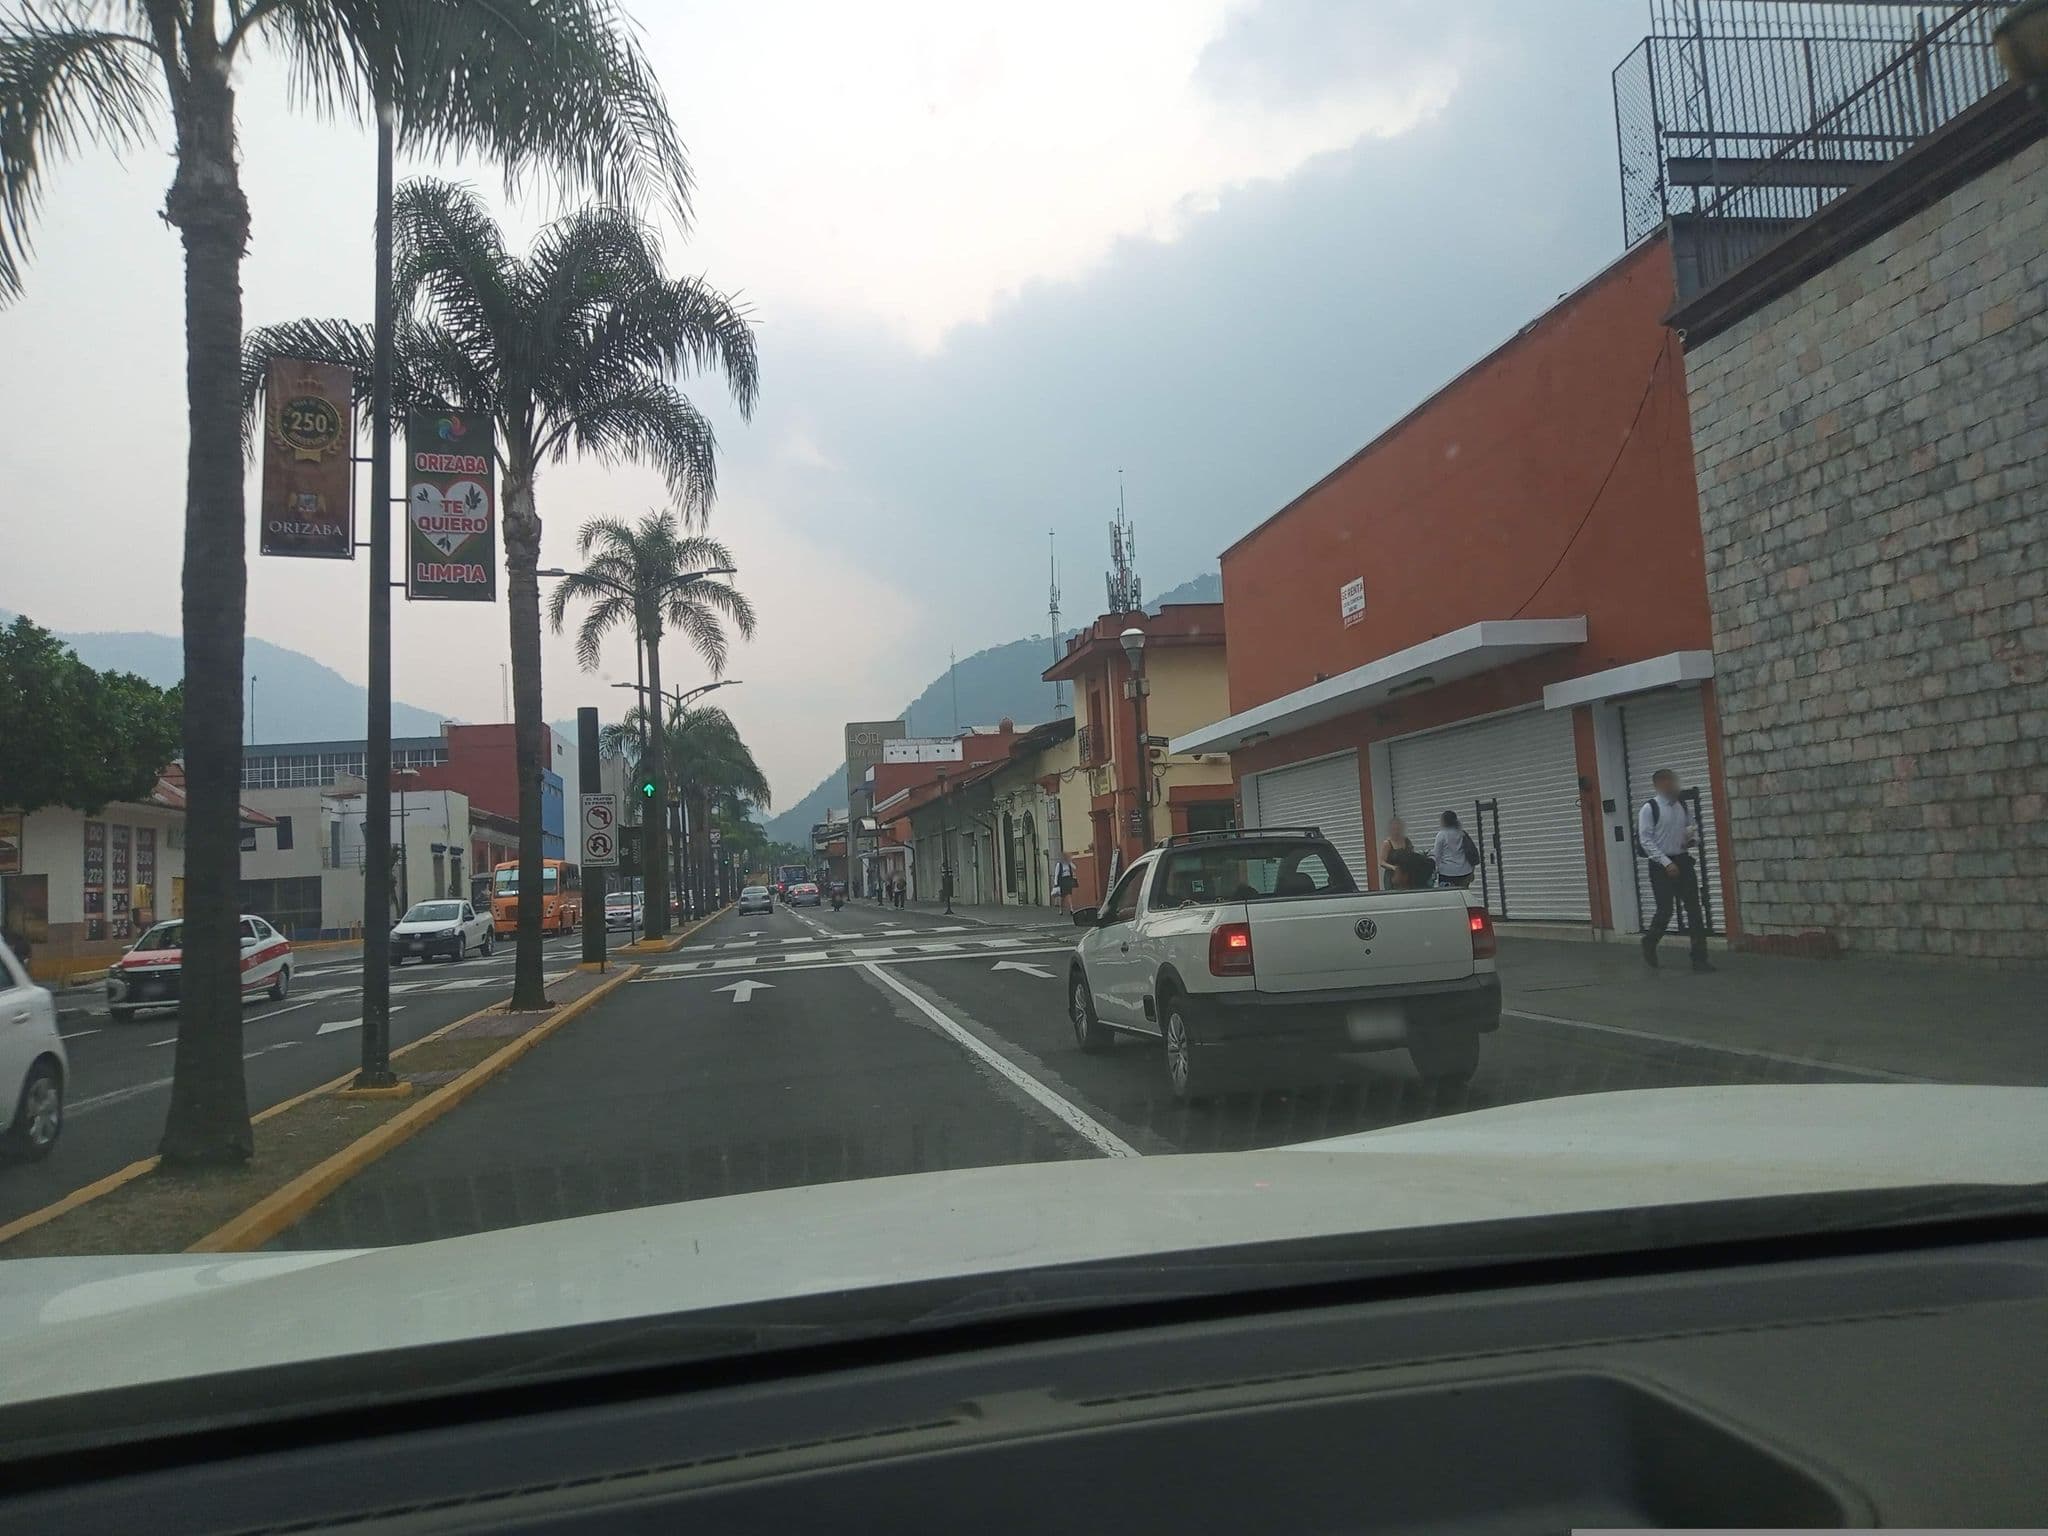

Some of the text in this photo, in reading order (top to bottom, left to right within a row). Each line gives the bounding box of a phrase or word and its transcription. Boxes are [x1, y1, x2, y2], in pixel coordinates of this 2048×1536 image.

[290, 411, 327, 433] 250
[415, 453, 488, 474] ORIZABA
[440, 499, 465, 515] TE
[268, 520, 343, 536] ORIZABA
[418, 516, 488, 534] QUIERO
[417, 564, 487, 583] LIMPIA
[849, 732, 880, 744] HOTEL
